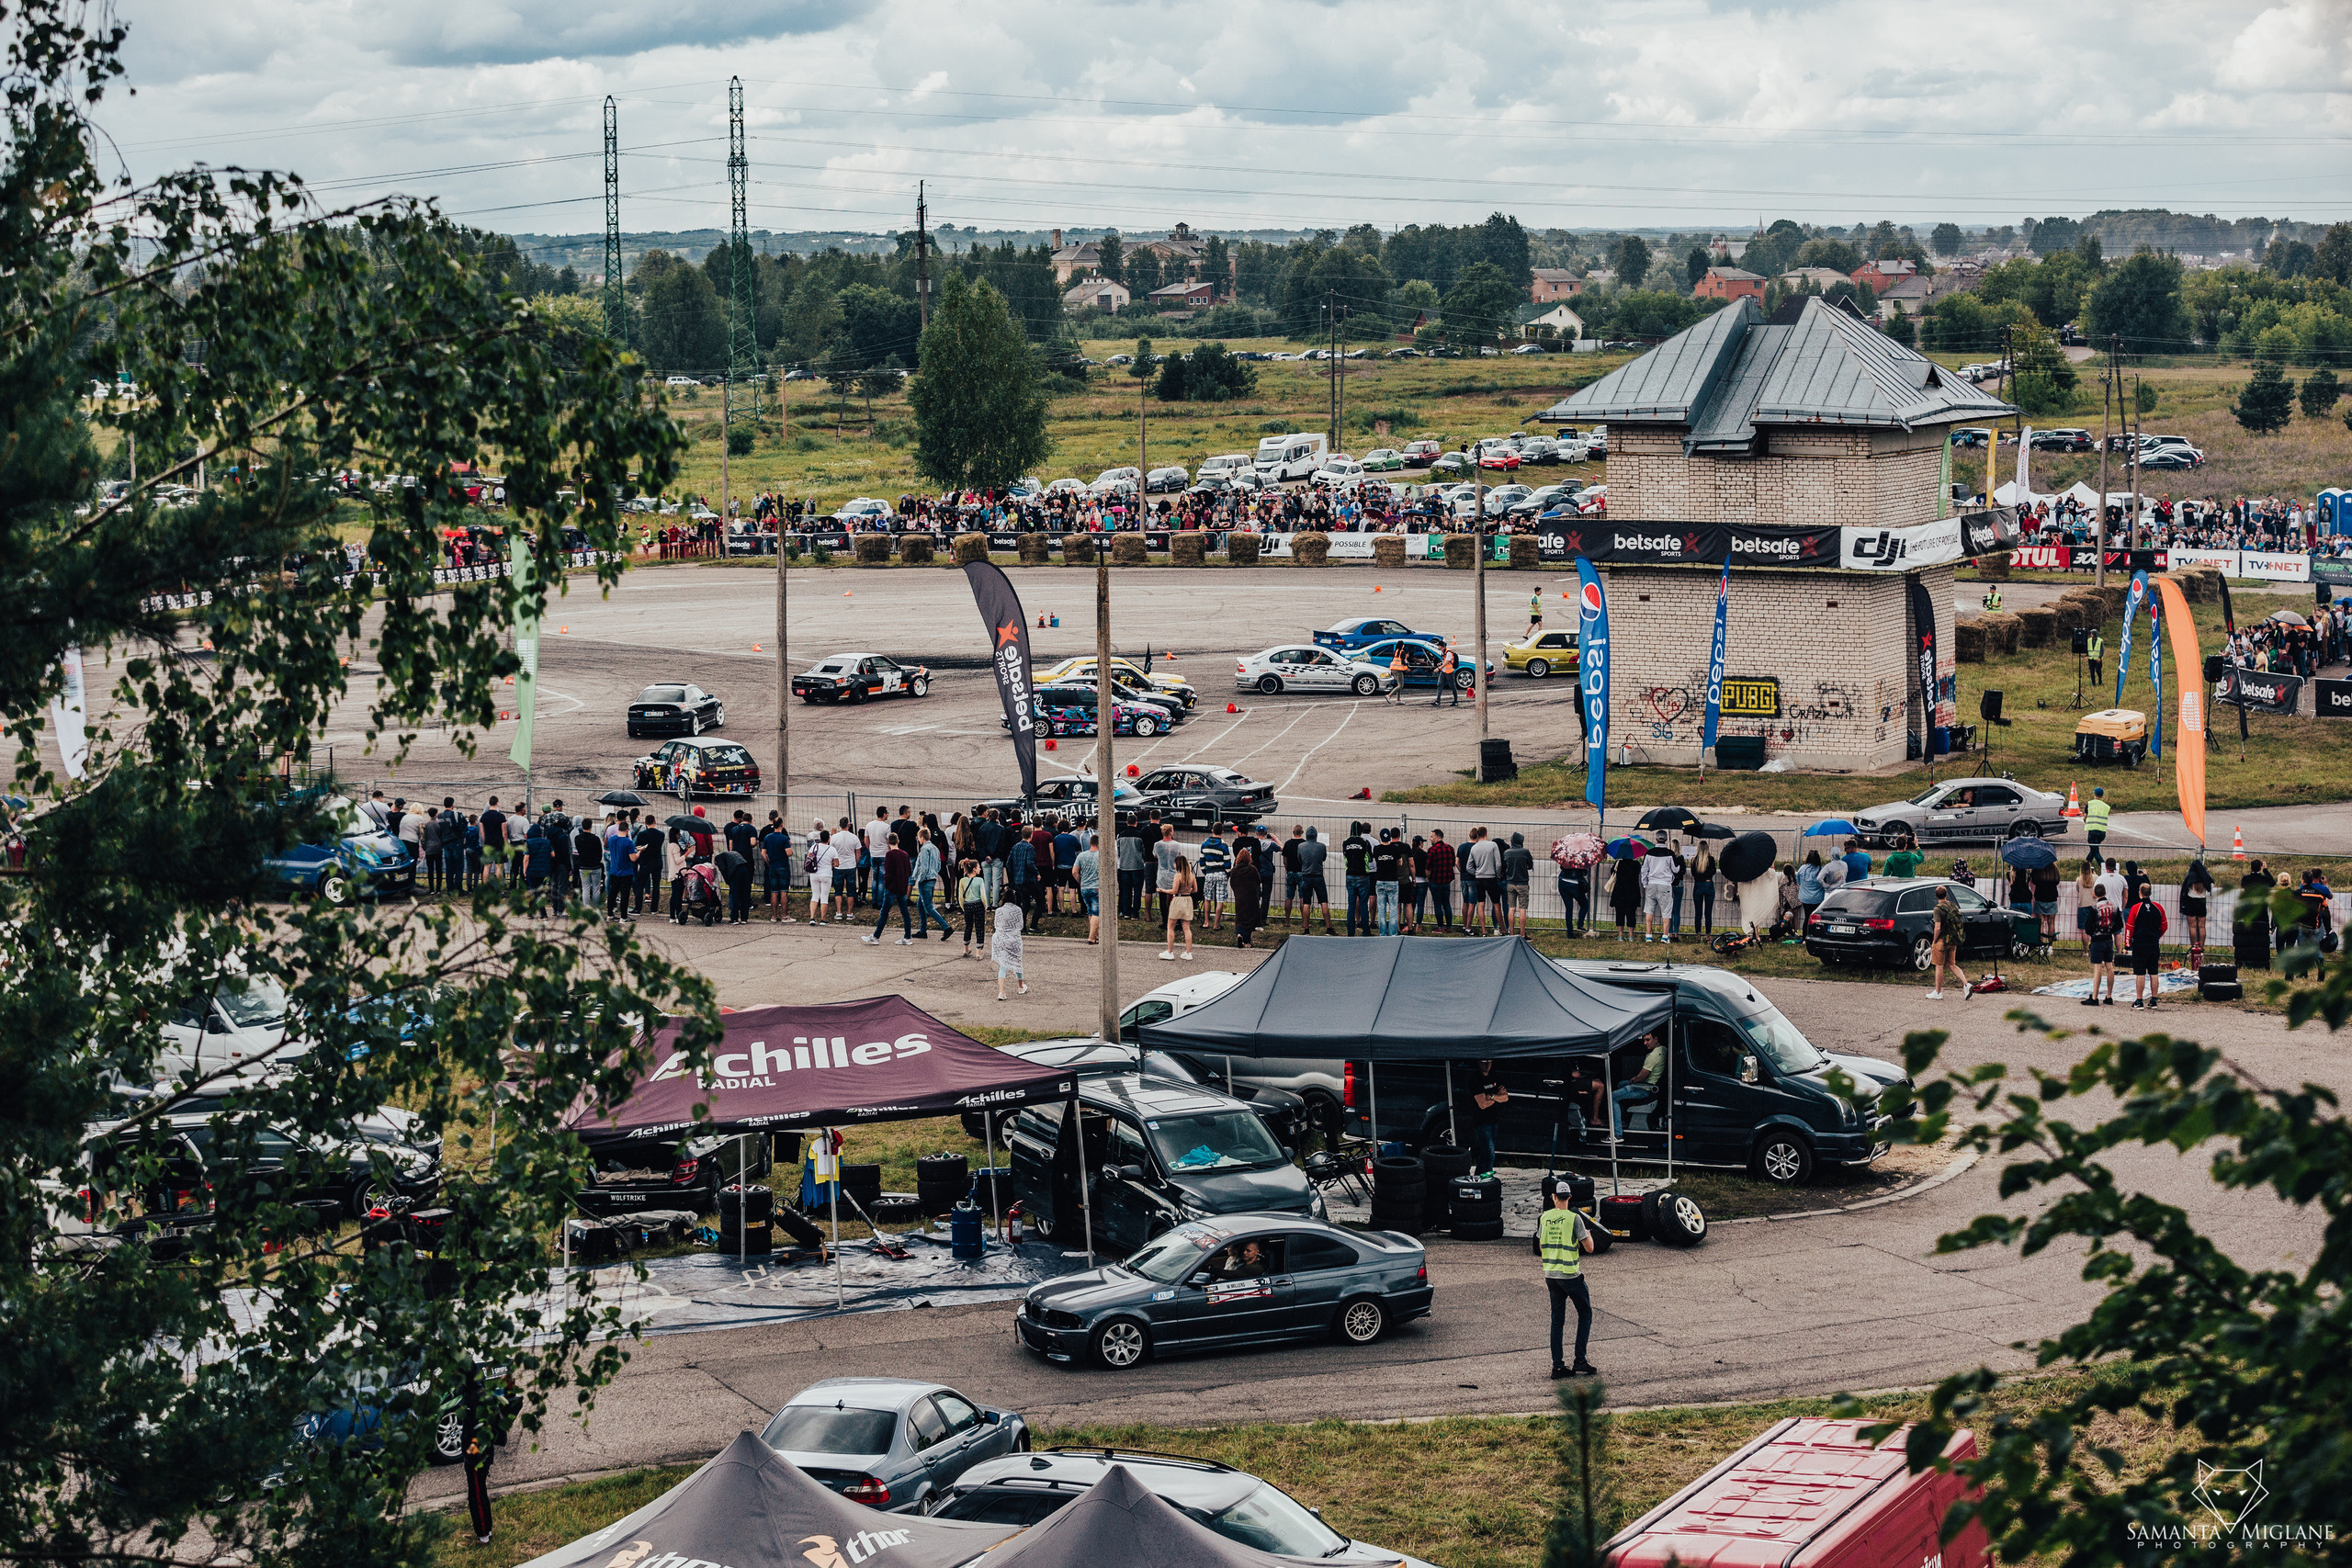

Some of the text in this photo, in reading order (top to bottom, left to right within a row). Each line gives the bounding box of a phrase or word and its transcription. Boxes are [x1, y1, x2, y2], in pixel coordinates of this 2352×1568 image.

[1334, 540, 1367, 548] POSSIBLE
[1614, 534, 1681, 550] betsafe
[1731, 536, 1800, 554] betsafe
[2313, 562, 2346, 572] CHIP
[1708, 617, 1724, 705] pepsi
[883, 671, 902, 694] 85
[2241, 681, 2276, 699] betsafe
[1724, 684, 1772, 709] PUBG
[1973, 828, 2008, 836] GARAGE
[954, 1089, 1025, 1106] Achilles
